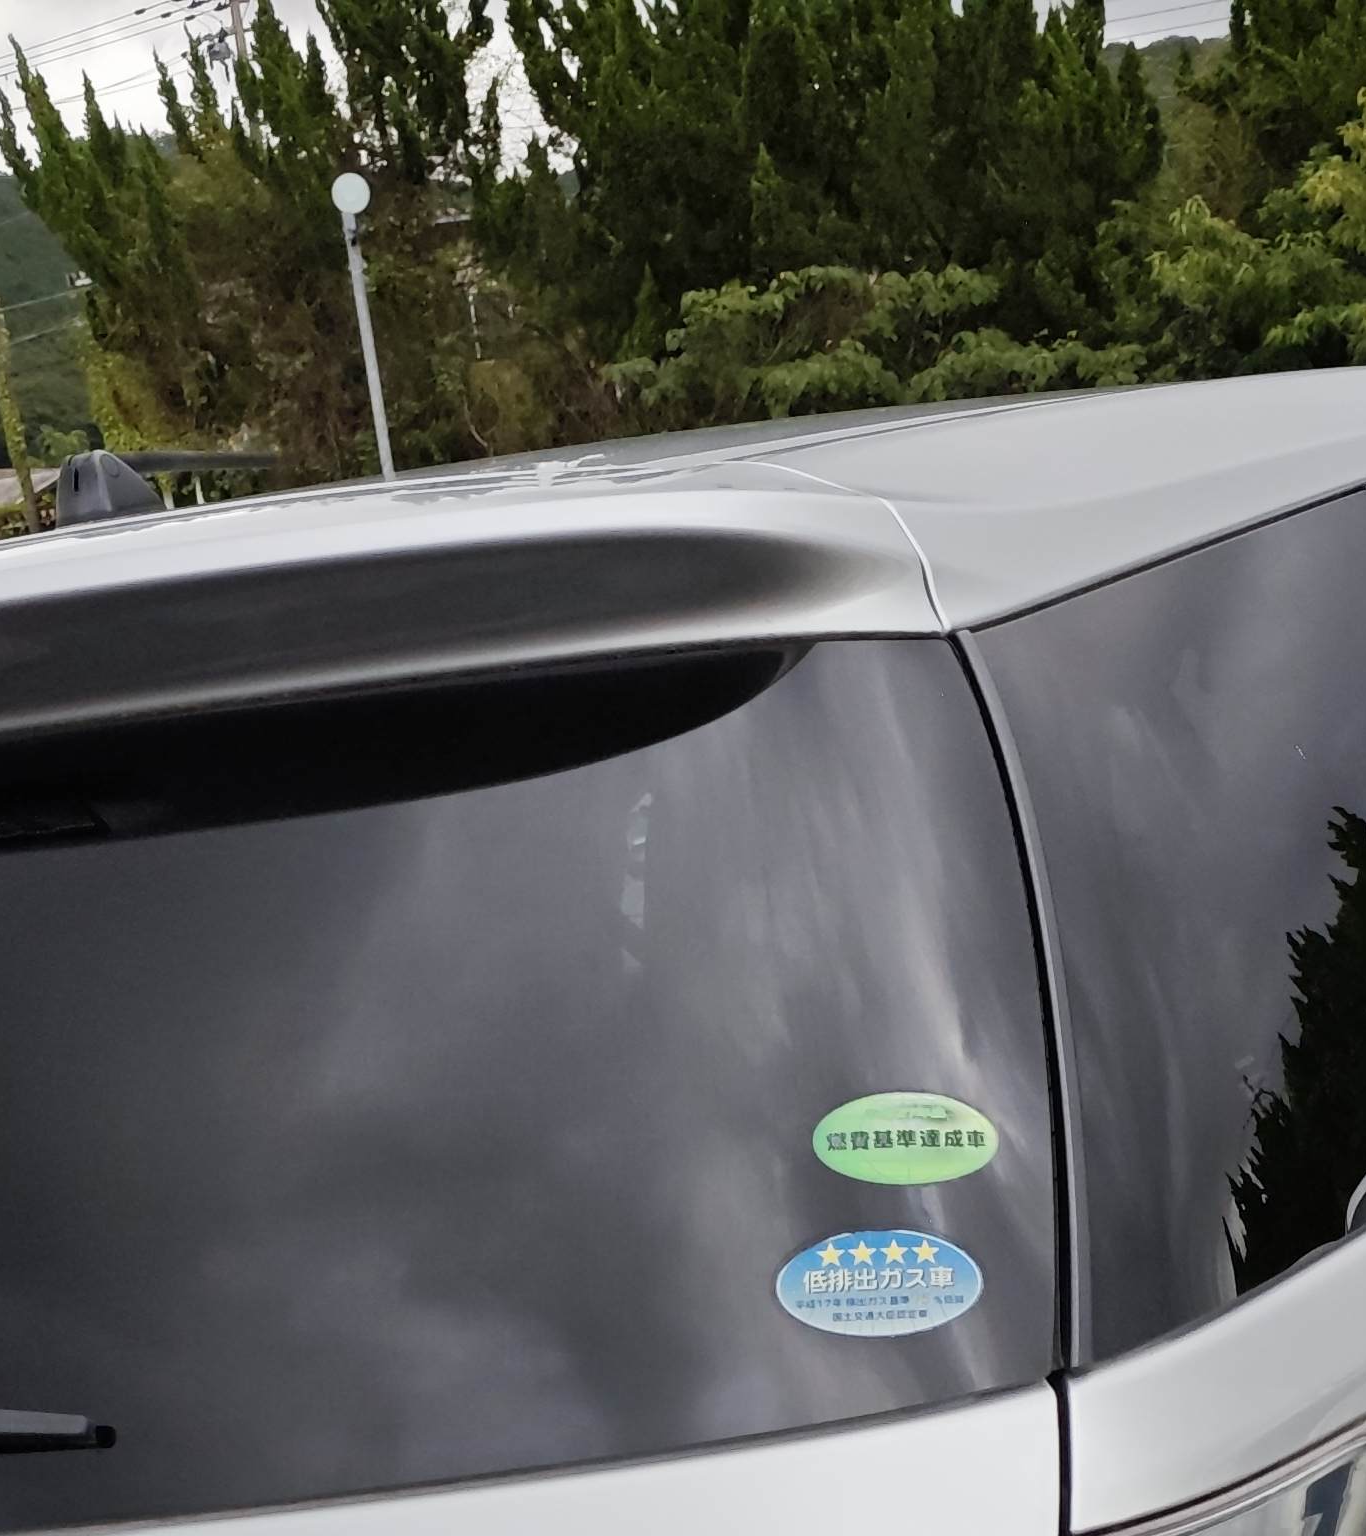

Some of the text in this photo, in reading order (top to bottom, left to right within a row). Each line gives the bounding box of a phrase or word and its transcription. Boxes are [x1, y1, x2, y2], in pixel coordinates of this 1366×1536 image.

[803, 1265, 955, 1294] 低排出ガス車
